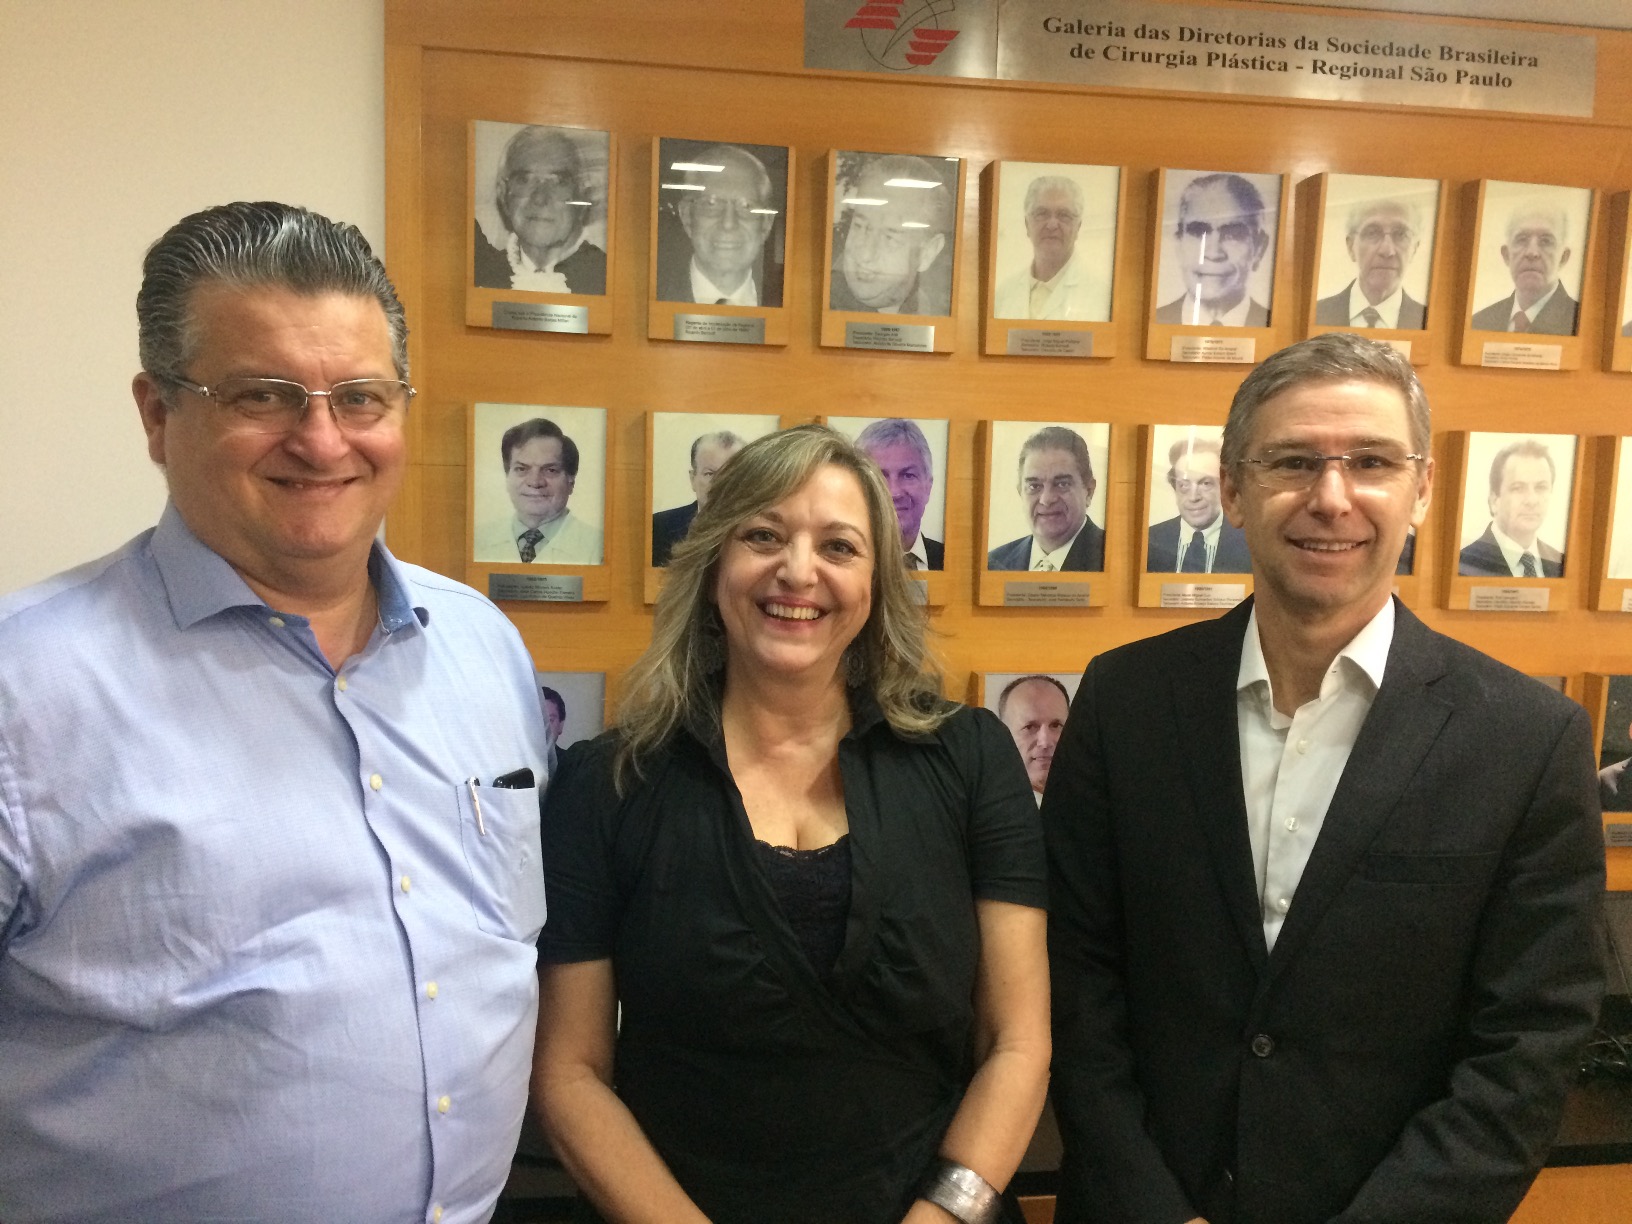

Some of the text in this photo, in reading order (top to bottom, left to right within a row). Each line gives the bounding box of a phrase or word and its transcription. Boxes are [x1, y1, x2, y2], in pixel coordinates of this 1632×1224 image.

[1043, 16, 1539, 68] Galeria das Diretorias da Sociedade Brasileira
[1069, 43, 1096, 60] de
[1102, 44, 1198, 69] Cirurgia
[1206, 50, 1289, 72] Plástica
[1312, 59, 1404, 81] Regional
[1410, 65, 1448, 84] São
[1455, 69, 1513, 89] Paulo
